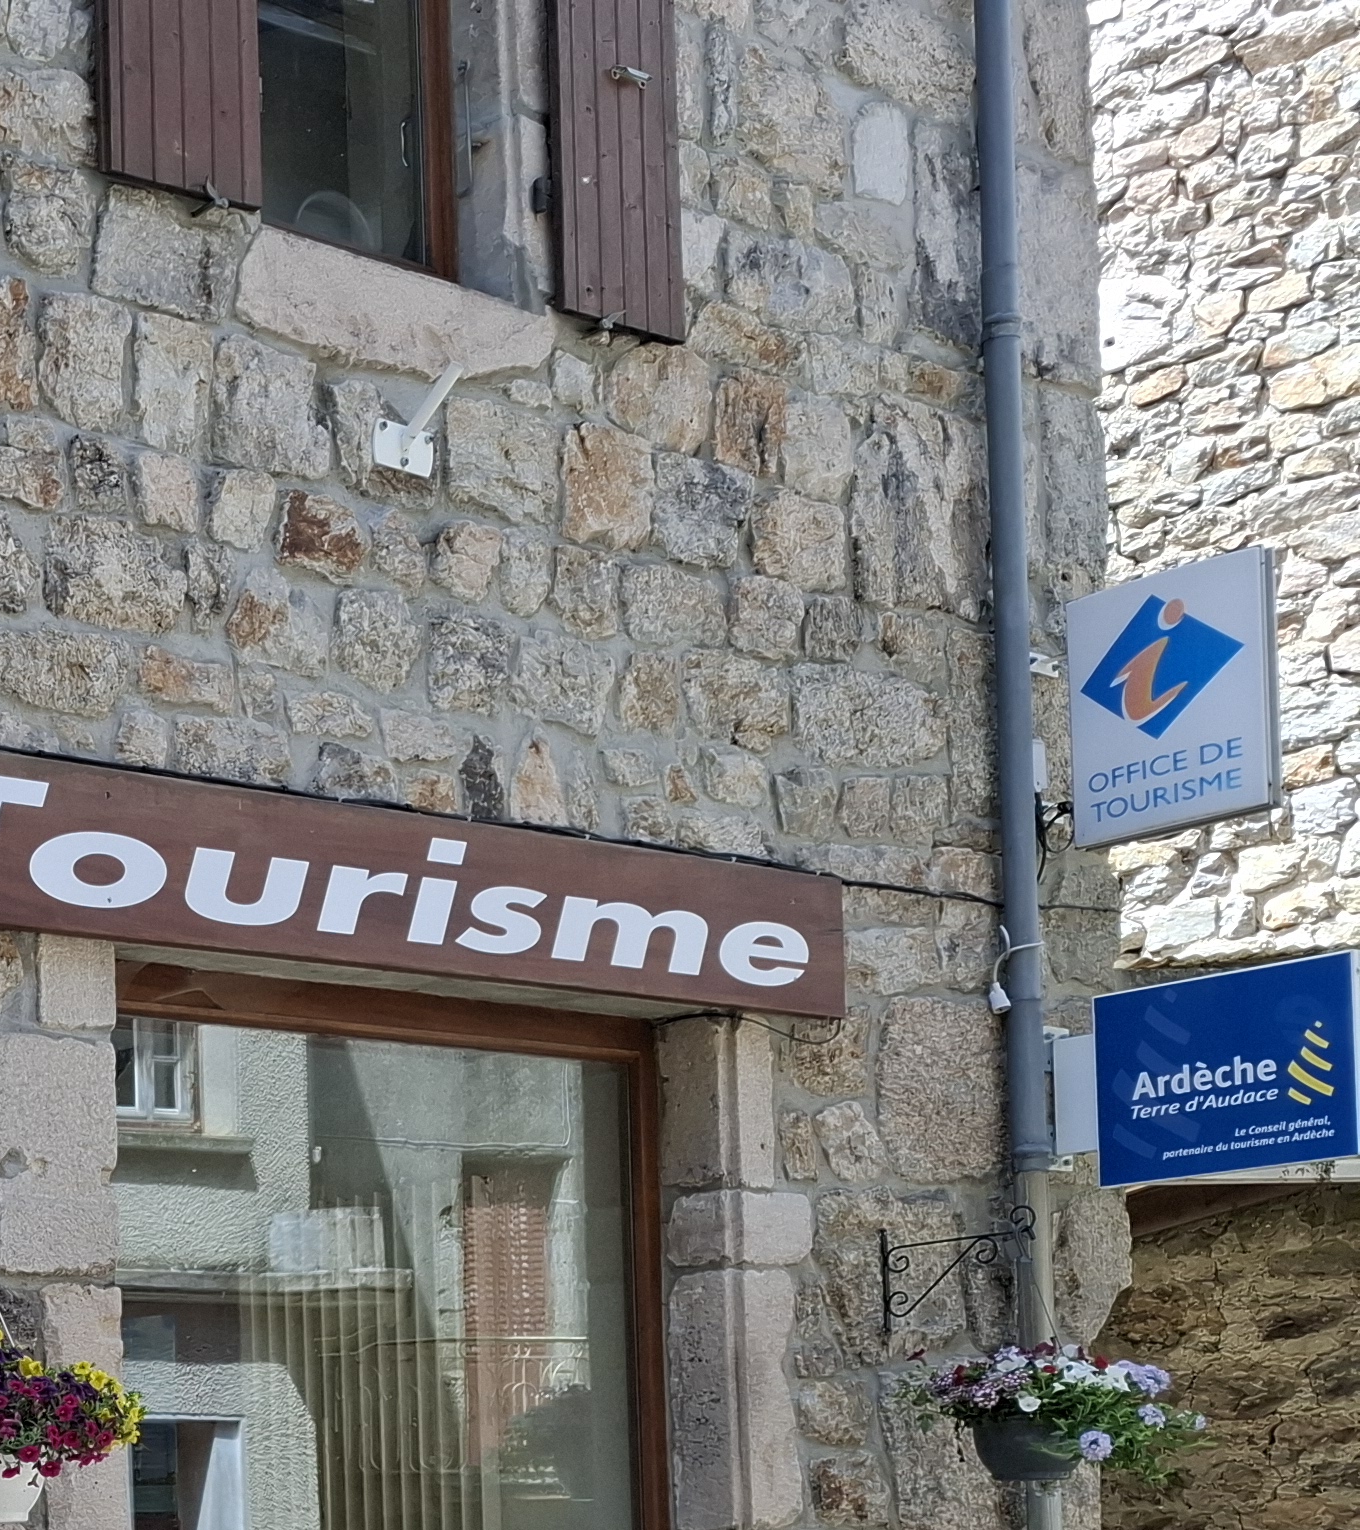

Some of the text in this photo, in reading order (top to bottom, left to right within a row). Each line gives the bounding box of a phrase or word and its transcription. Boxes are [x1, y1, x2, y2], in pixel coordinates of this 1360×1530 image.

[1088, 737, 1243, 794] OFFICE DE
[1090, 768, 1243, 823] TOURISME
[1132, 1055, 1278, 1101] Ardèche
[1131, 1088, 1279, 1120] Terre d'Audace
[1163, 1127, 1335, 1160] partenaire du tourisme en Ardèche
[1235, 1115, 1331, 1137] Le Conseil général,
